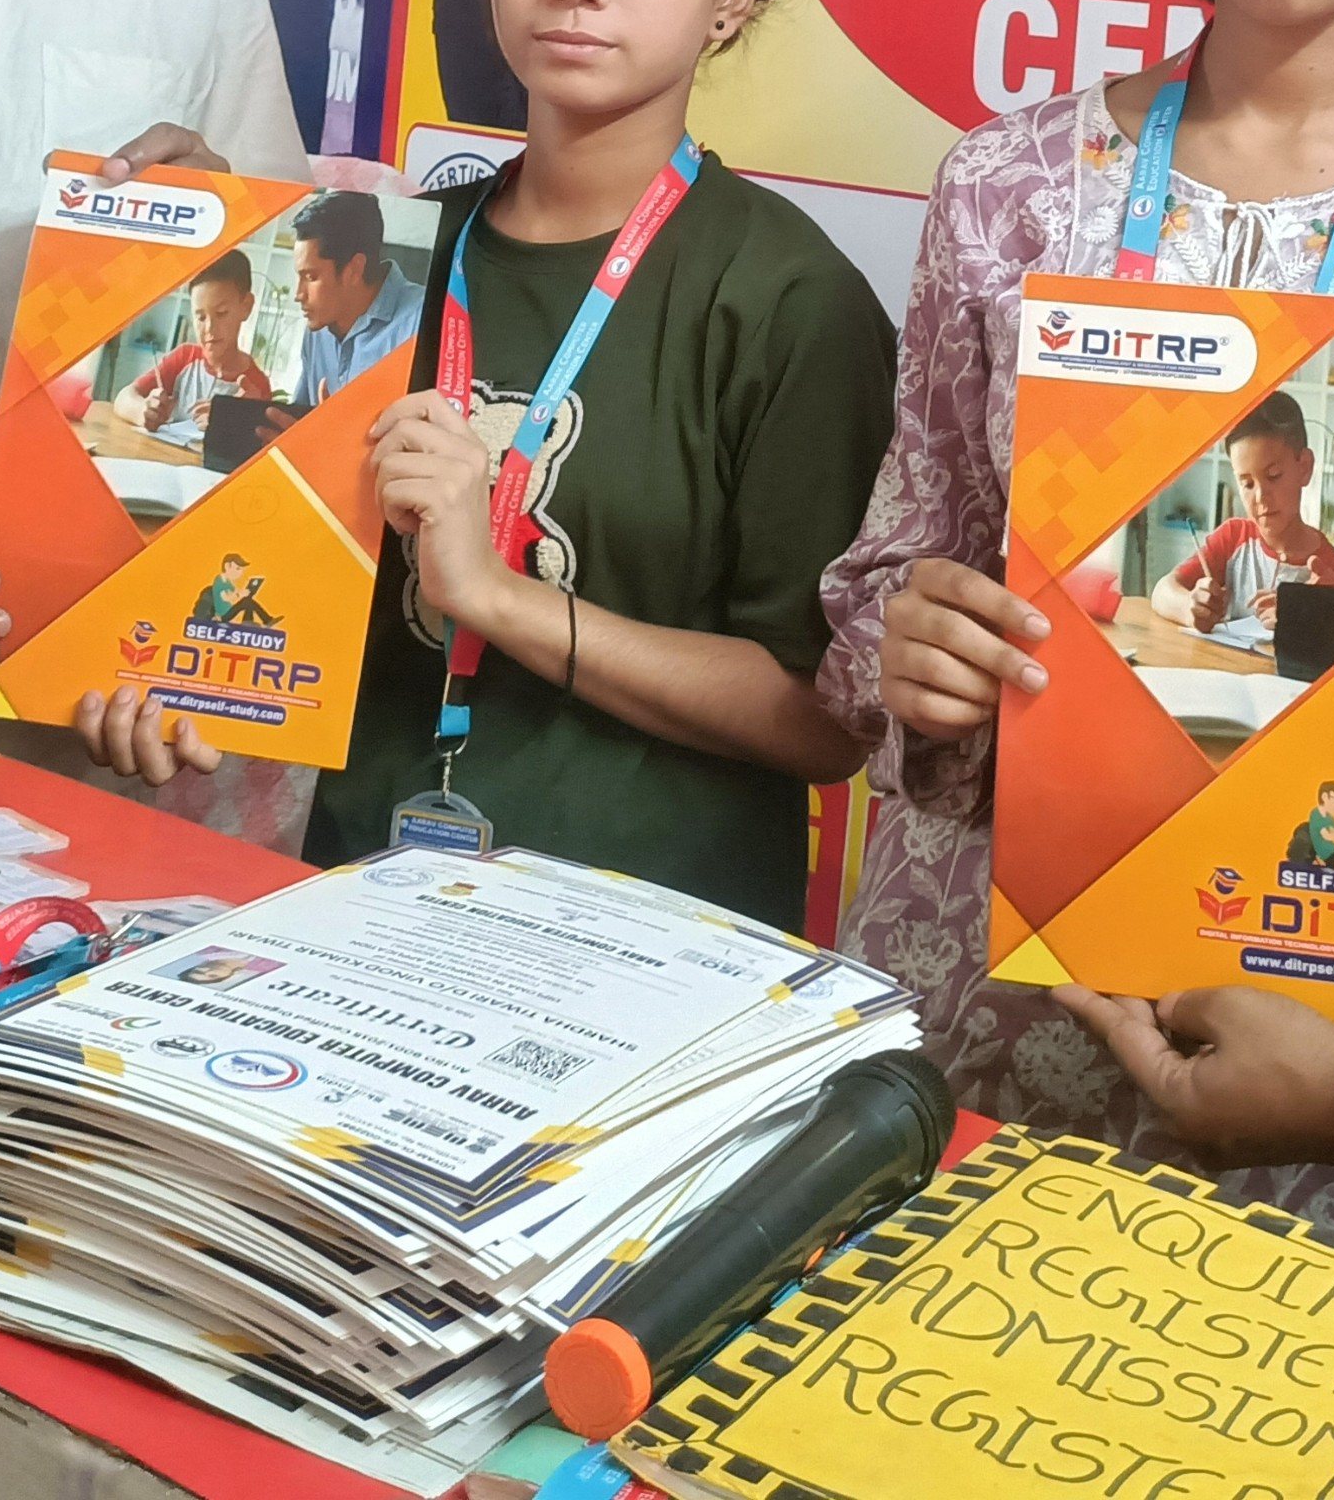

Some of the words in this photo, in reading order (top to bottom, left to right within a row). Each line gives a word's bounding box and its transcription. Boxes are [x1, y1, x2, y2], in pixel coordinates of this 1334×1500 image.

[428, 163, 493, 192] CERTIF
[90, 193, 197, 225] DiTRP
[1081, 327, 1219, 363] DiTRP
[185, 623, 286, 651] SELF-STUDY
[166, 643, 323, 694] DiTRP
[413, 893, 469, 910] CENTER
[464, 906, 543, 929] EDUCATION
[225, 929, 296, 949] TIWARI
[540, 927, 620, 952] COMPUTER
[1198, 928, 1229, 940] DIGITAL
[1229, 931, 1283, 947] INFORMATION
[291, 945, 365, 967] KUMAR
[614, 949, 669, 967] AARAV
[361, 963, 429, 984] VINOD
[101, 980, 195, 1008] CENTER
[425, 980, 471, 996] D/O
[263, 977, 484, 1052] Certificate
[465, 992, 540, 1018] TIWARI
[187, 1001, 322, 1044] EDUCATION
[314, 1038, 453, 1089] COMPUTER
[444, 1083, 541, 1121] AARAV
[803, 1333, 1285, 1500] REGISTE
